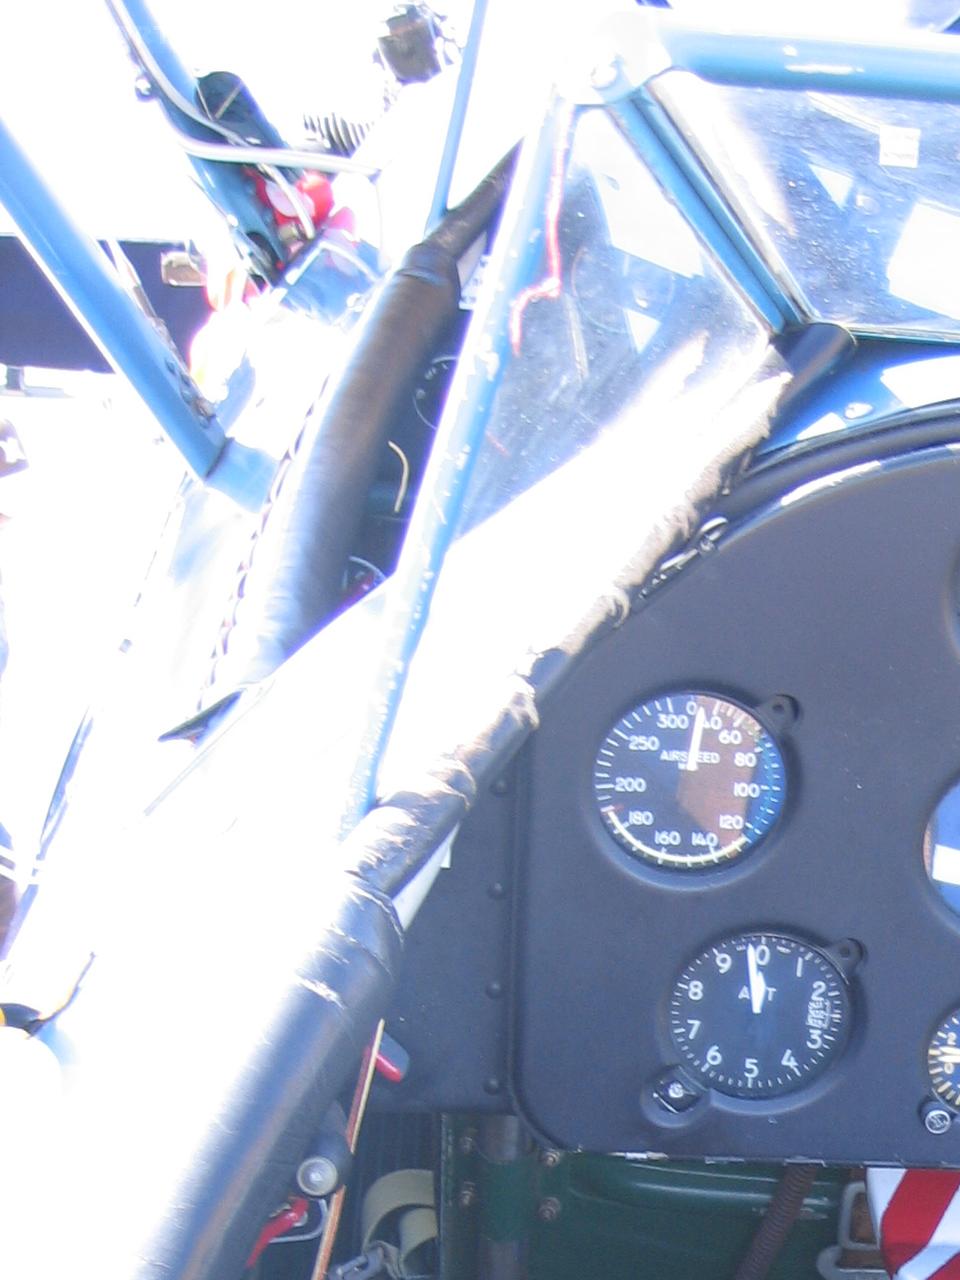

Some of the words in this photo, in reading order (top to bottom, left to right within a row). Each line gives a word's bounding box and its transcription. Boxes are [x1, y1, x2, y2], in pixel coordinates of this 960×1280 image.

[657, 715, 688, 729] 300
[629, 737, 659, 750] 250
[718, 731, 742, 744] 60
[660, 750, 720, 764] AIRSEED
[734, 753, 756, 767] 80
[615, 778, 646, 792] 200
[733, 783, 760, 797] 100
[629, 811, 653, 825] 180
[719, 815, 743, 829] 120
[654, 831, 681, 845] 160
[691, 832, 718, 847] 140
[755, 944, 770, 966] 0
[715, 953, 732, 974] 9
[796, 956, 804, 977] 1
[687, 980, 703, 1000] 8
[738, 985, 776, 1001] AT
[811, 980, 826, 1001] 2
[687, 1019, 701, 1040] 7
[806, 1029, 823, 1050] 3
[946, 1032, 957, 1046] 2
[706, 1045, 722, 1066] 6
[780, 1049, 799, 1067] 4
[743, 1058, 759, 1078] 5
[943, 1062, 955, 1075] 0
